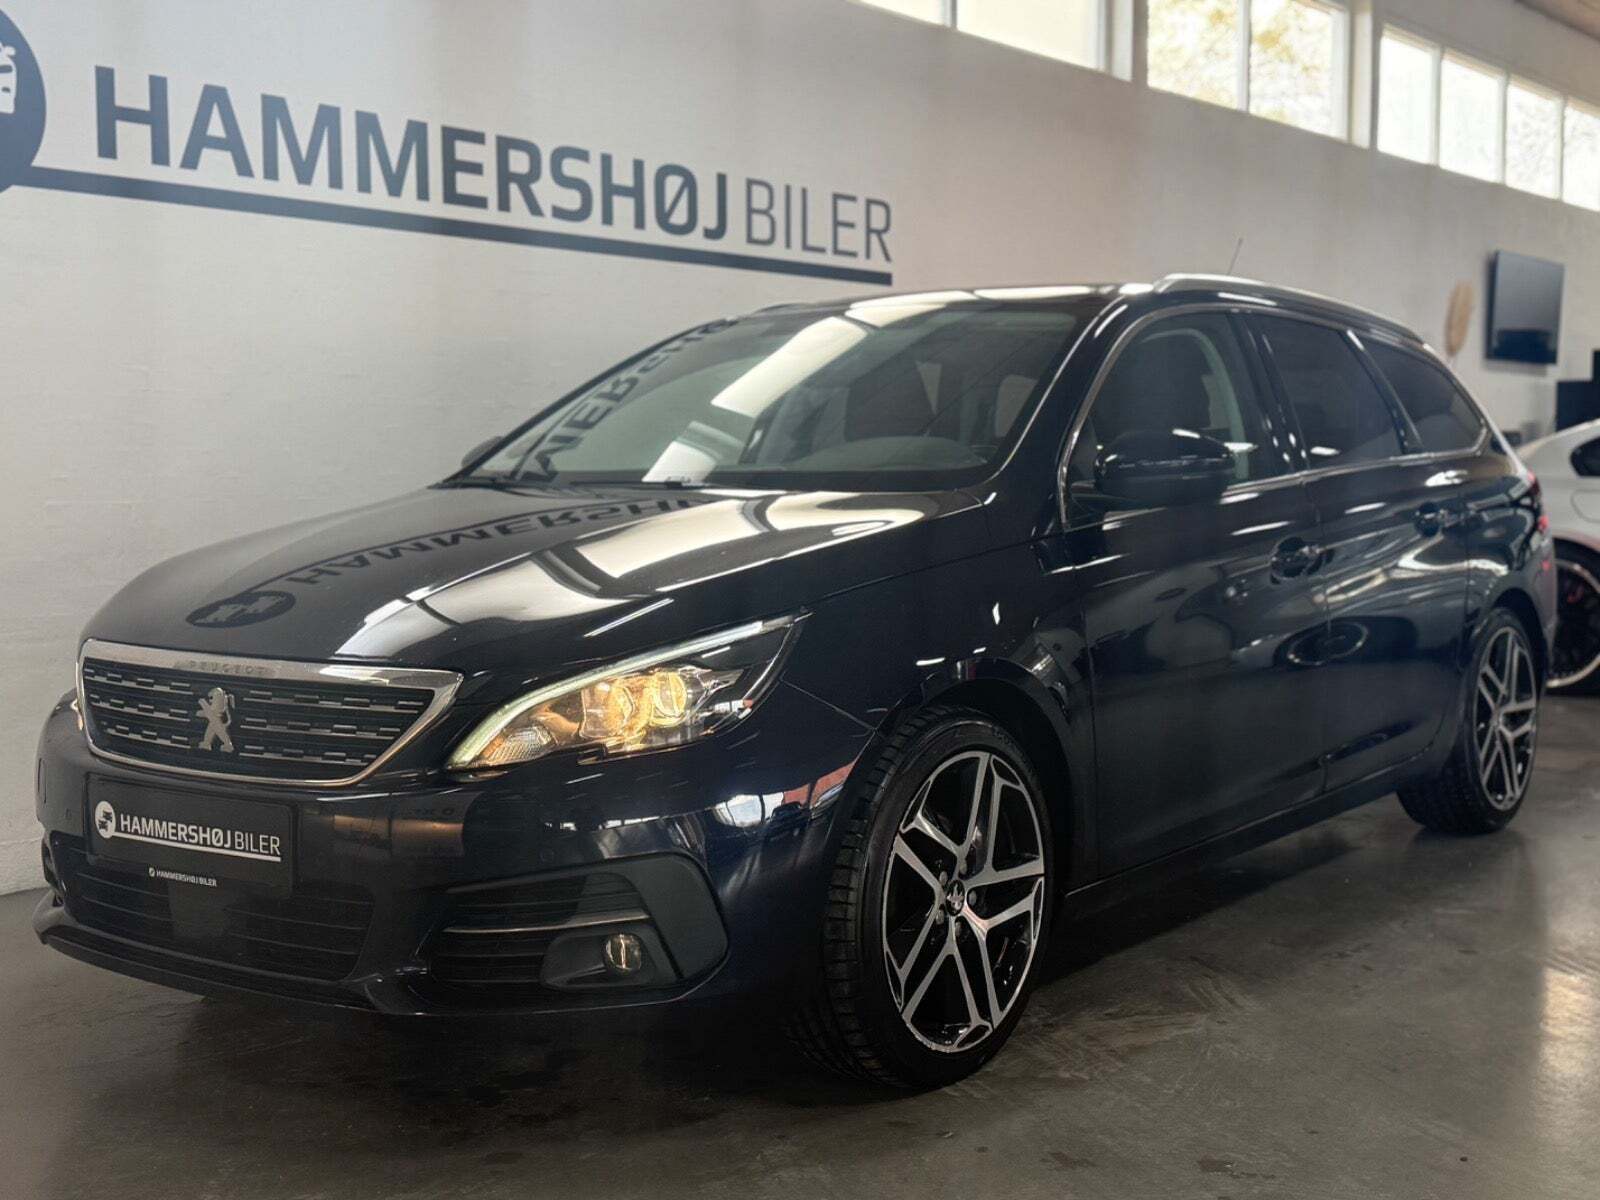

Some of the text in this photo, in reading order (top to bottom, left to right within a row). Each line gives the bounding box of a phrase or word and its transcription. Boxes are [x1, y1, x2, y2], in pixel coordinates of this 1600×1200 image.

[95, 65, 893, 263] HAMMERSHØJ BILER
[120, 813, 281, 856] HAMMERSHØJ BILER
